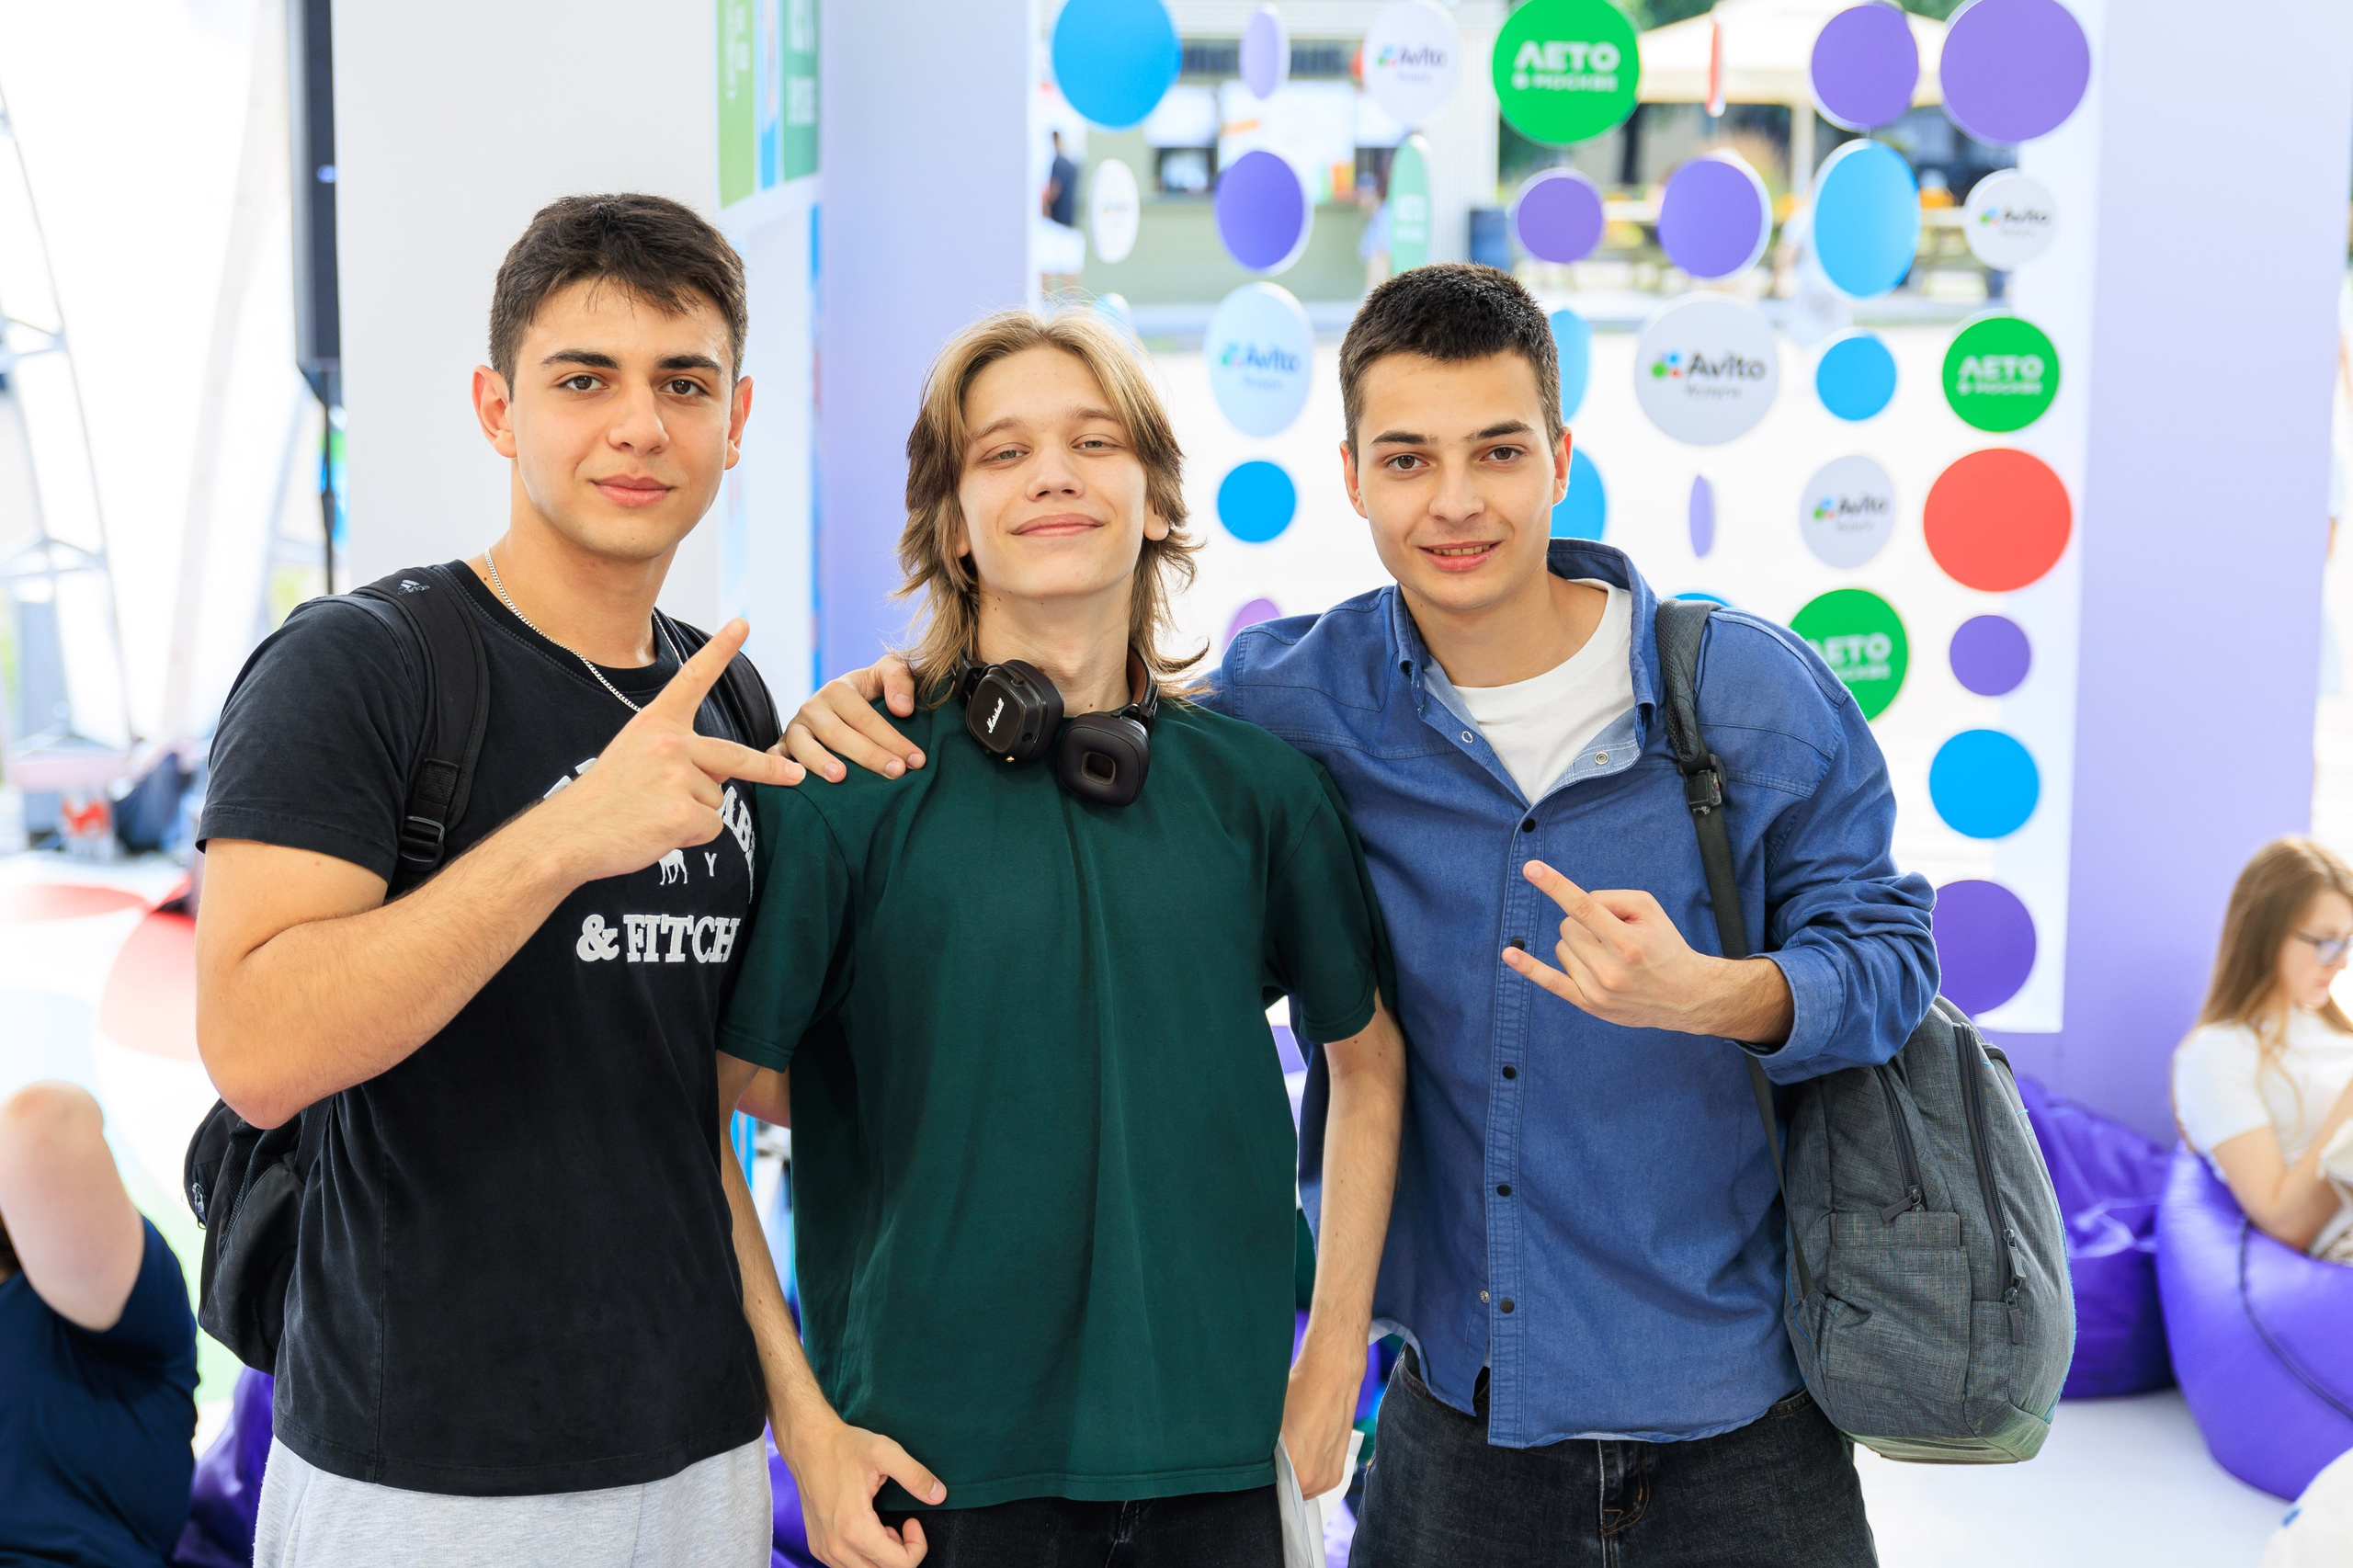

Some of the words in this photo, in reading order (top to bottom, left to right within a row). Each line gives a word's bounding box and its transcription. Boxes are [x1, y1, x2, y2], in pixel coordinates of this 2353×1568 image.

[1399, 46, 1447, 66] Avito
[1245, 344, 1301, 374] Avito
[1688, 350, 1767, 380] Avito
[1838, 496, 1890, 516] Avito
[704, 852, 718, 878] Y
[575, 914, 620, 962] &
[622, 914, 741, 963] FITCH
